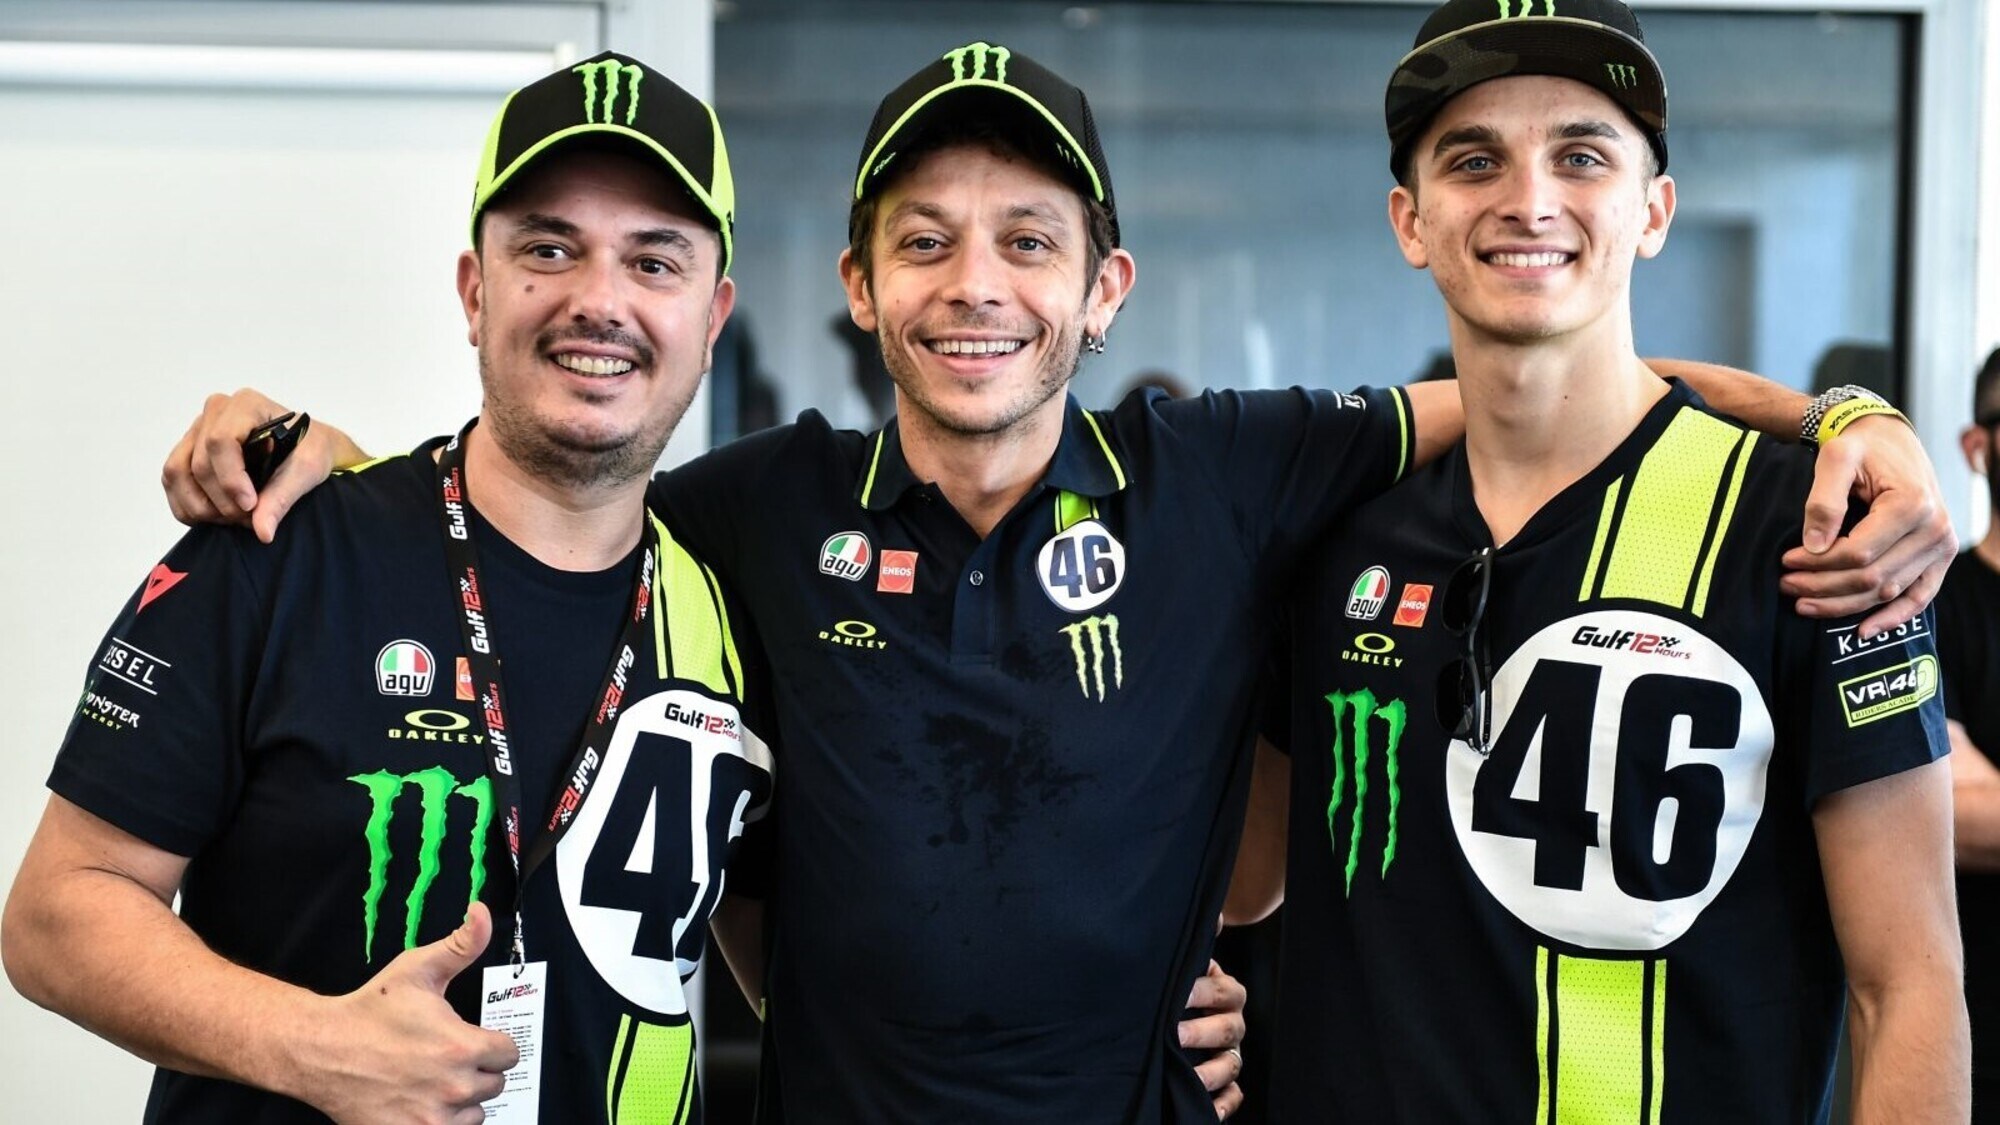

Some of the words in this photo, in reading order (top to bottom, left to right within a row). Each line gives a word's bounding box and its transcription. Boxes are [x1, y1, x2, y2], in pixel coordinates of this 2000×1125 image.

[882, 566, 913, 577] ENEOS
[1049, 534, 1117, 598] 46
[1401, 600, 1427, 611] ENEOS
[818, 631, 887, 650] OAKLEY
[1342, 650, 1403, 668] OAKLEY
[385, 674, 426, 694] agv
[388, 728, 484, 744] OAKLEY
[1472, 658, 1742, 902] 46
